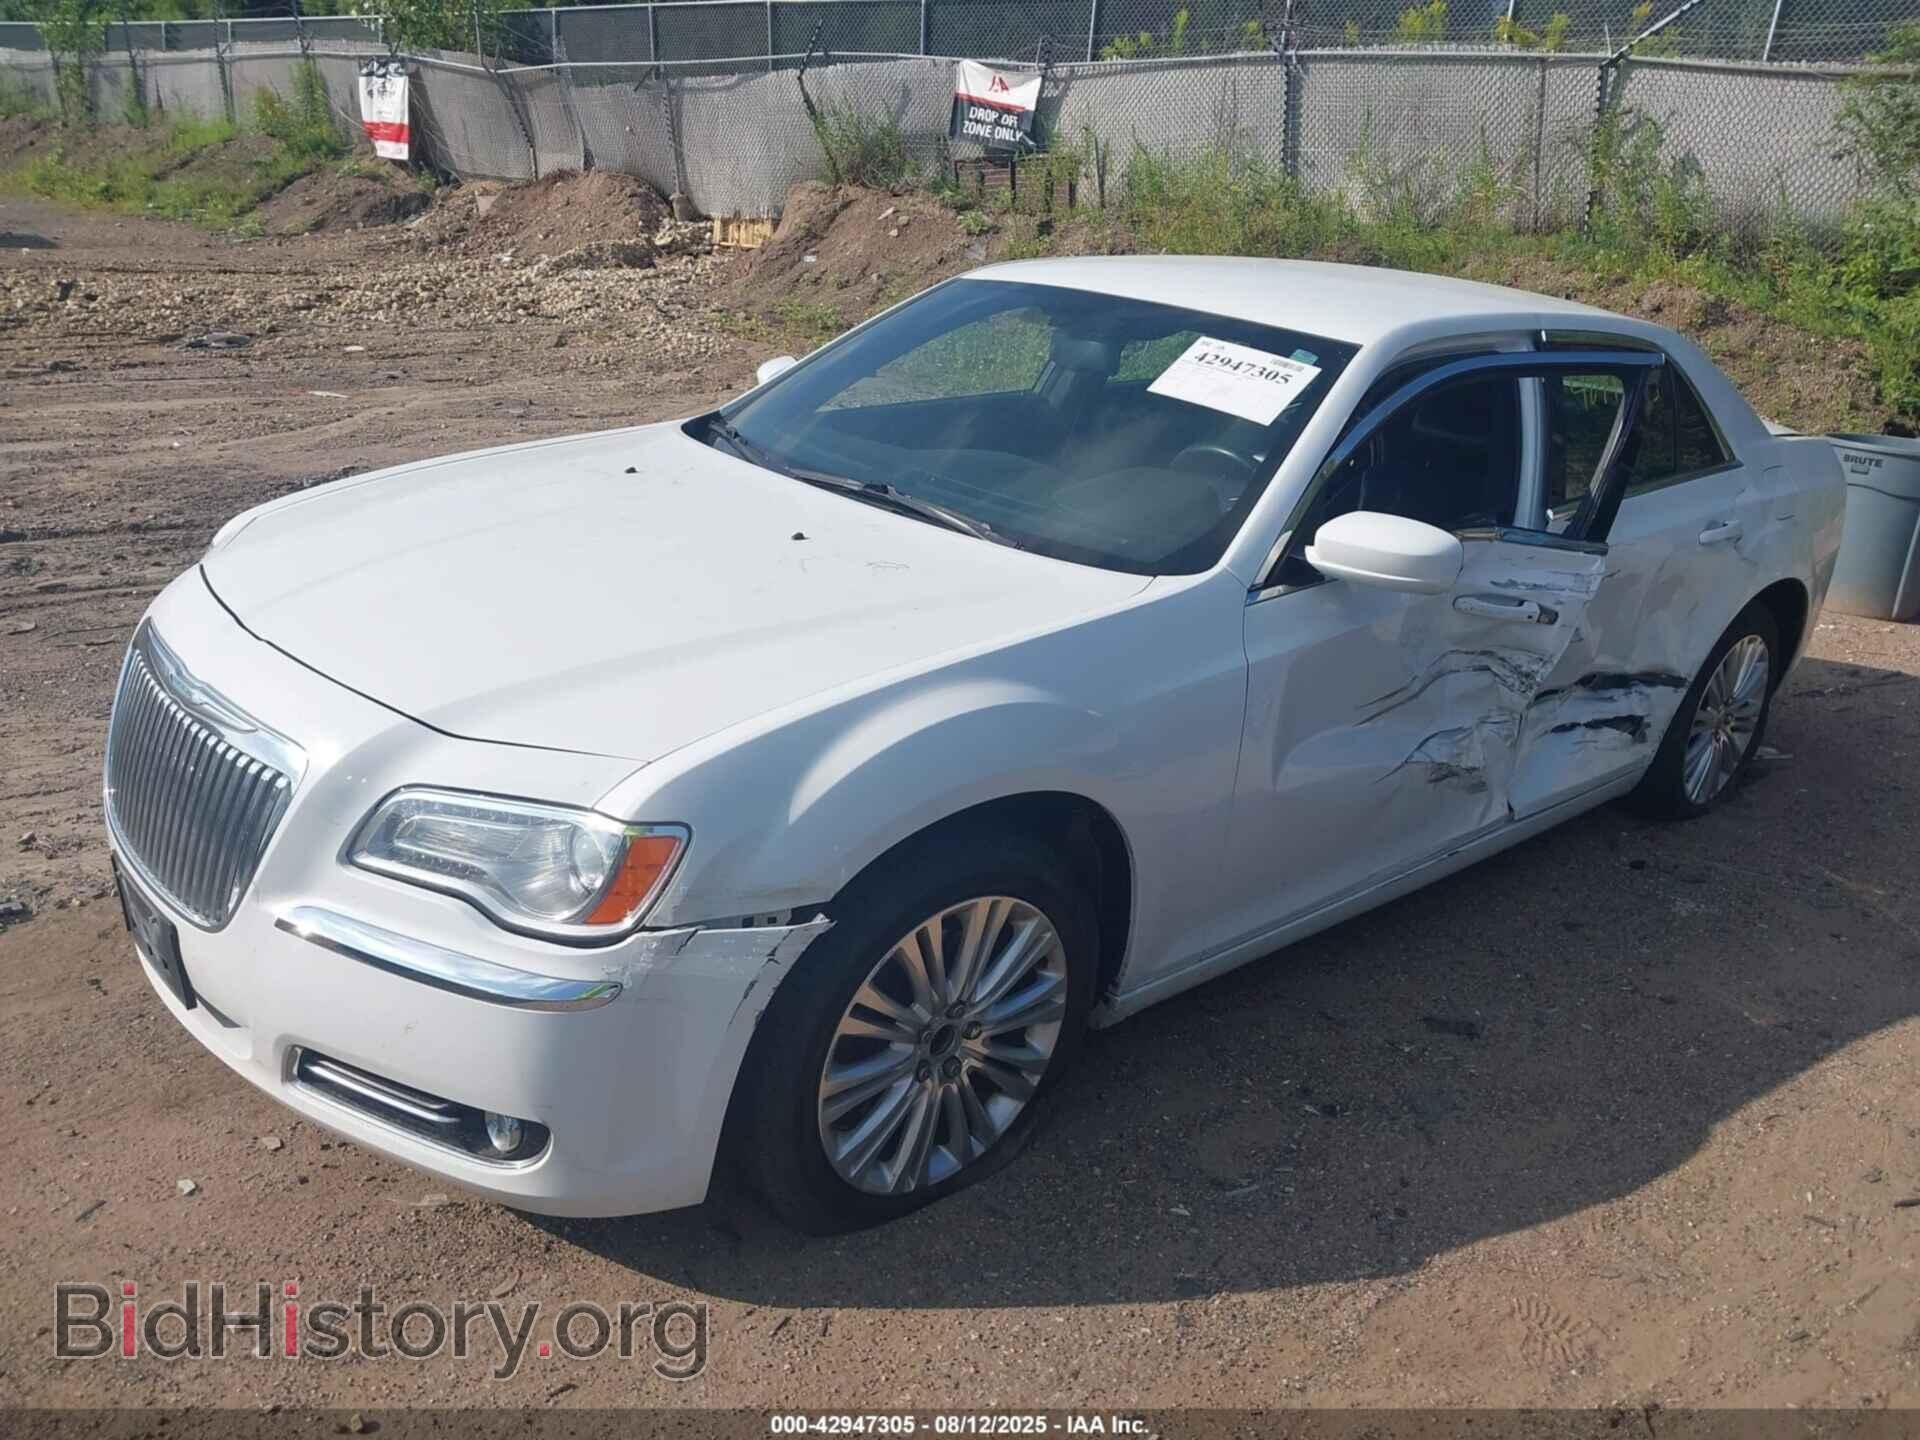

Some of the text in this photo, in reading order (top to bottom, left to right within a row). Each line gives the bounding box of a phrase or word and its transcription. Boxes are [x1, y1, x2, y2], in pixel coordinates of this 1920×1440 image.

[970, 107, 1018, 127] DROP OFF
[963, 121, 1023, 141] ZONE ONLY
[1194, 352, 1293, 385] 42947305
[1843, 454, 1884, 468] BRUTE
